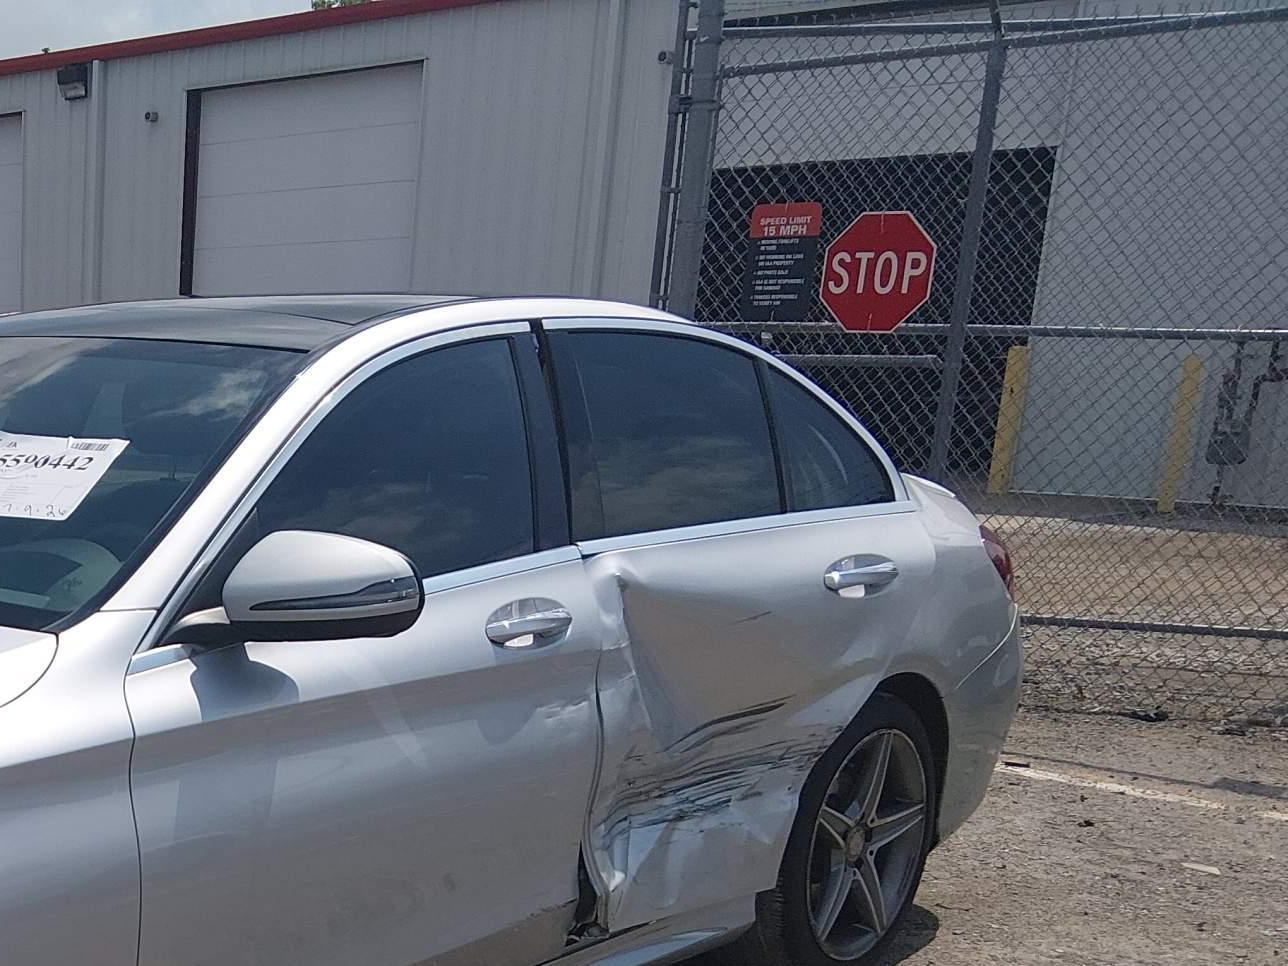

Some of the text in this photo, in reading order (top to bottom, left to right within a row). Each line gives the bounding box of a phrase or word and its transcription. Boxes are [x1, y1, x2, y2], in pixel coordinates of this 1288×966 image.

[760, 215, 812, 225] SPEED LIMIT
[764, 225, 807, 237] 15 MPH
[828, 251, 928, 294] STOP
